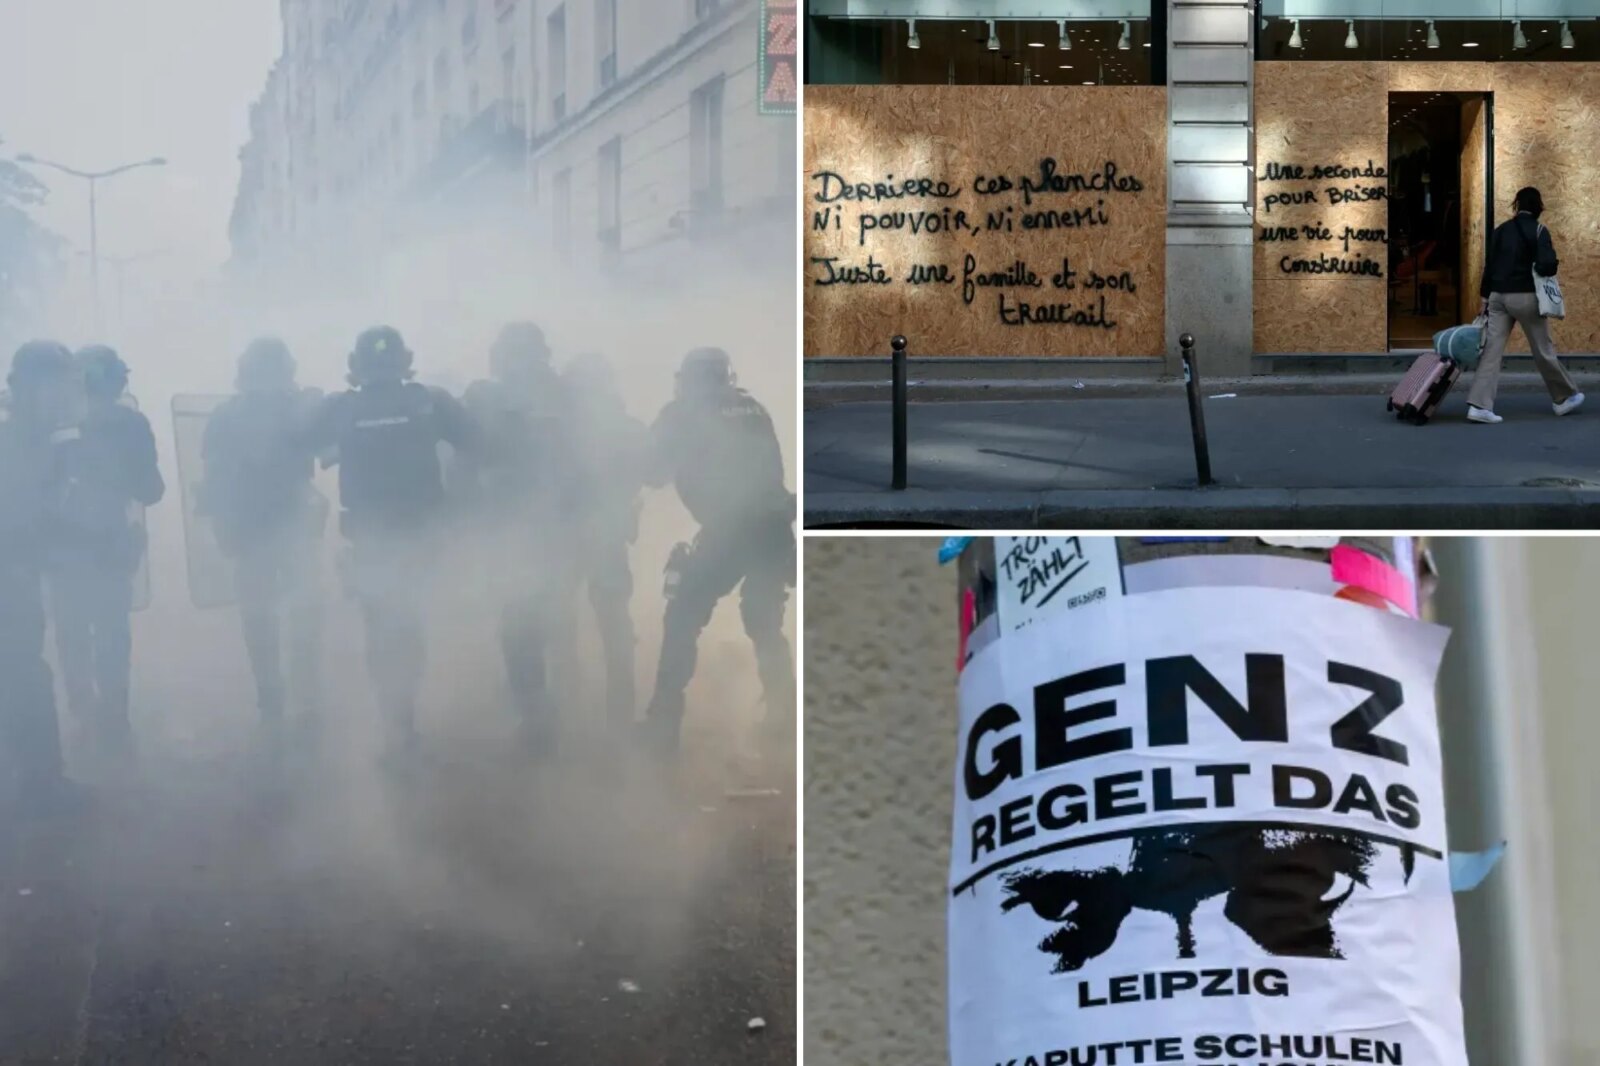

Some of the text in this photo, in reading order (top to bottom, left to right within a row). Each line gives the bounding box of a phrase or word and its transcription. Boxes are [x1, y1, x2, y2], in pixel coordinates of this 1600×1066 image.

[766, 0, 797, 102] ZA
[973, 174, 1013, 194] ces
[1020, 157, 1145, 204] planches
[1308, 160, 1388, 180] seconde
[1259, 221, 1388, 252] une vie pour
[810, 253, 1137, 305] Juste une famille et son
[1000, 536, 1049, 581] TRO
[963, 652, 1410, 801] GEN Z
[971, 764, 1421, 864] REGELT DAS
[1077, 967, 1290, 1009] LEIPZIG
[994, 1033, 1403, 1066] PUTTE SCHULEN
